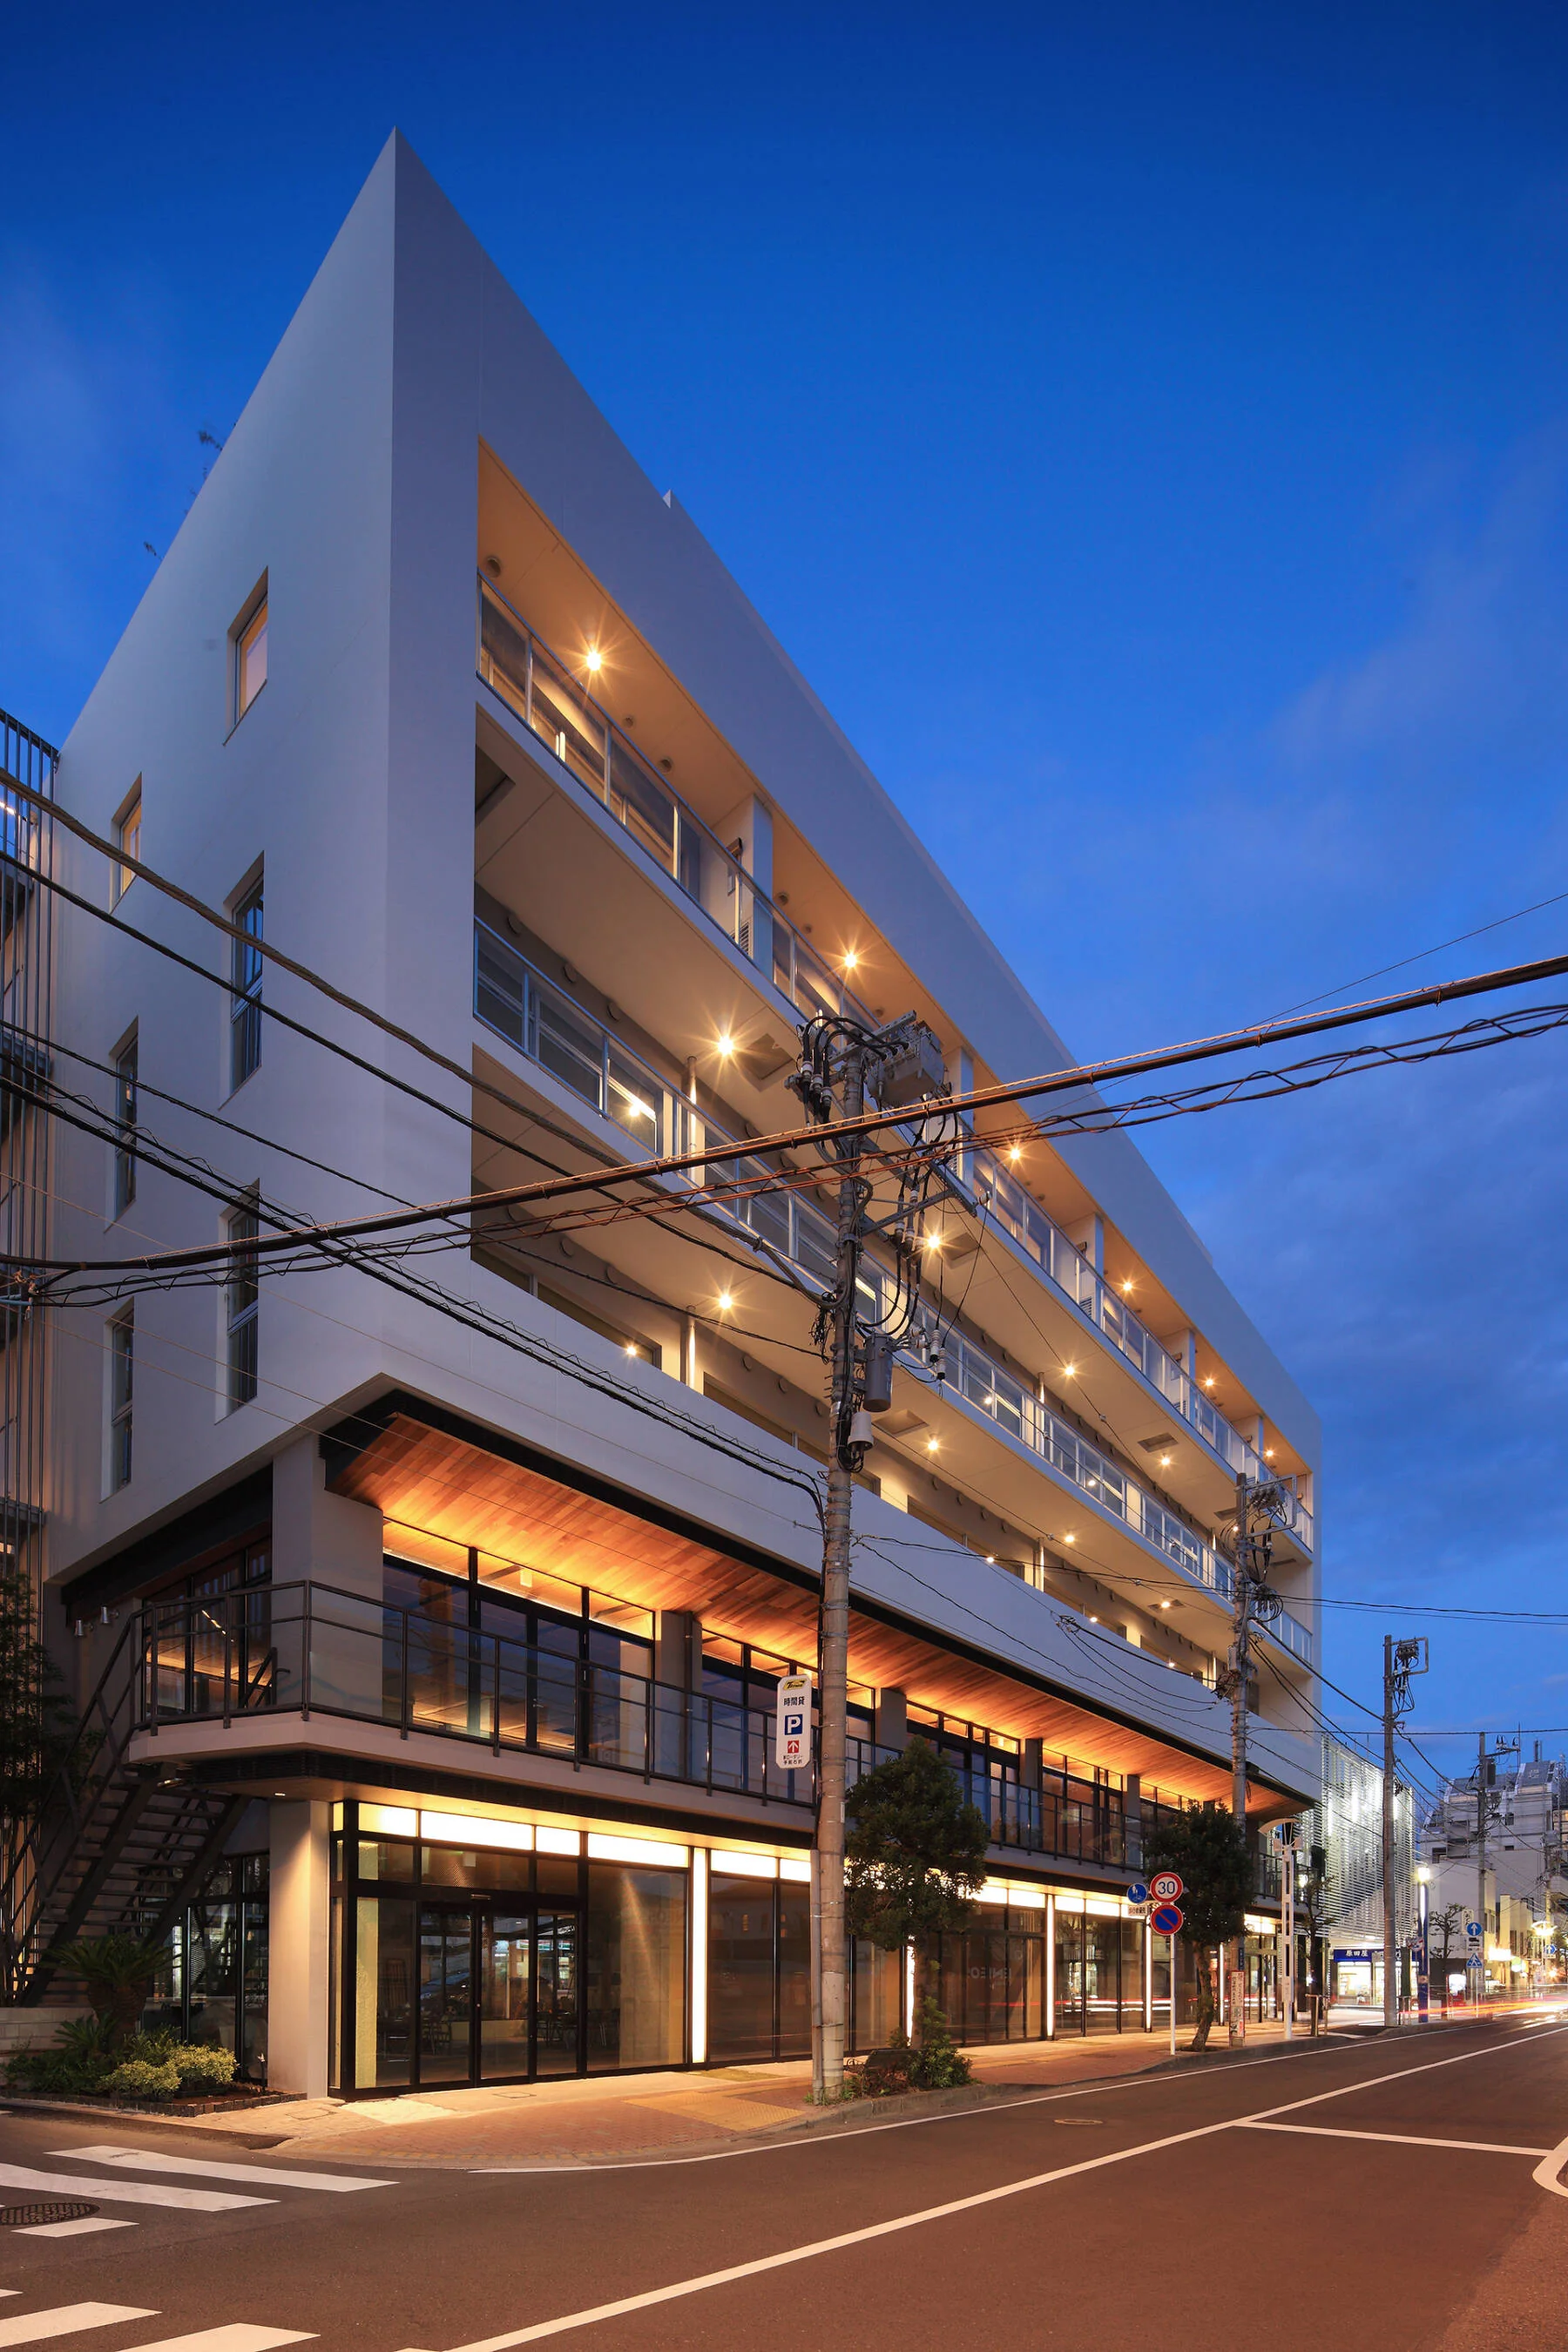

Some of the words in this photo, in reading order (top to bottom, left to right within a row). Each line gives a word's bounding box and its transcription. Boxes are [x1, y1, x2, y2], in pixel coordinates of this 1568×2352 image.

[783, 1696, 805, 1707] 時間貸
[787, 1716, 801, 1734] P
[1158, 1881, 1176, 1895] 30
